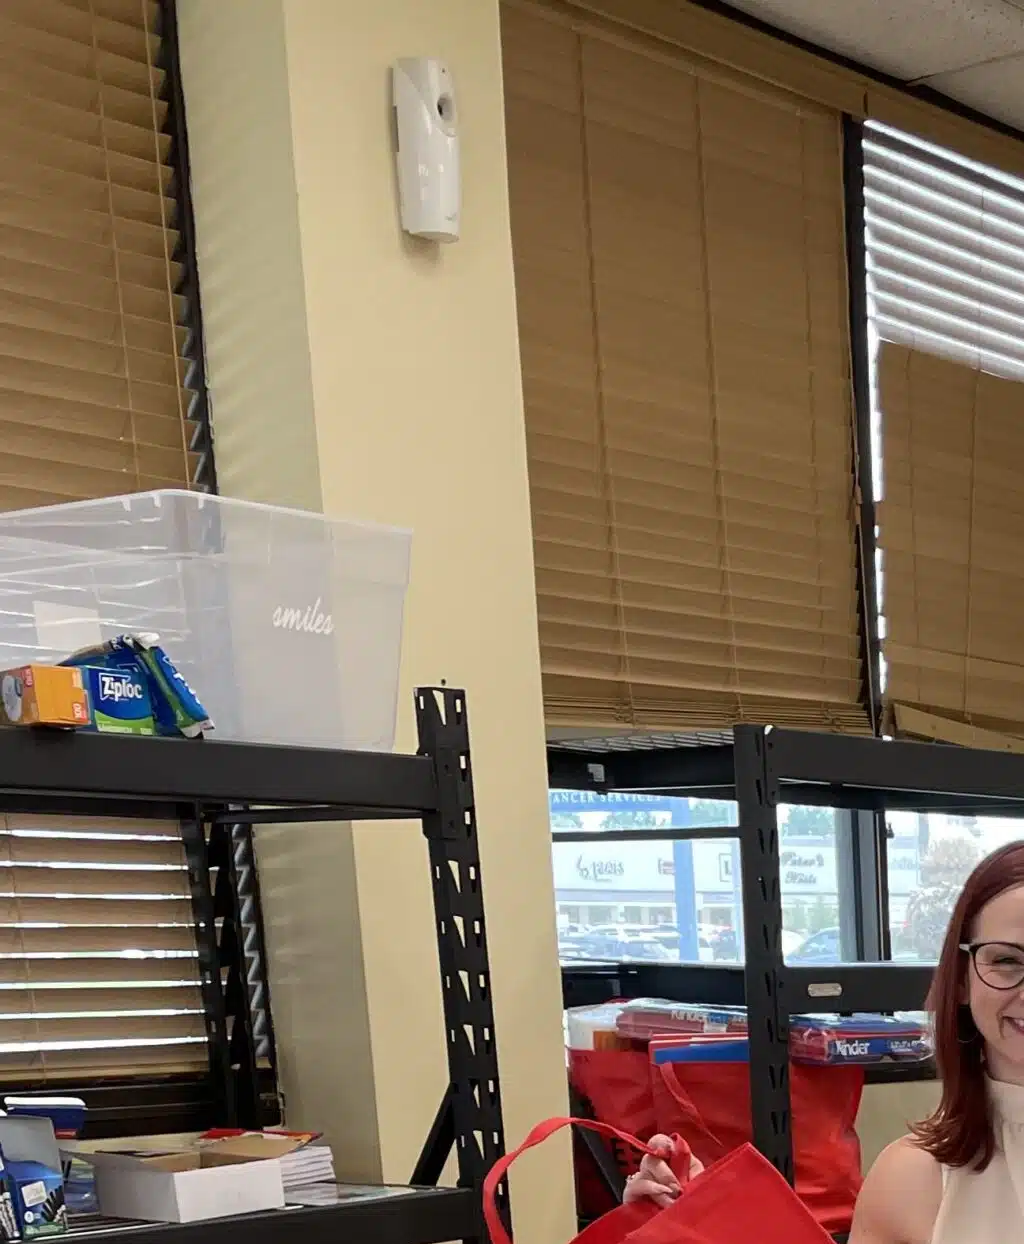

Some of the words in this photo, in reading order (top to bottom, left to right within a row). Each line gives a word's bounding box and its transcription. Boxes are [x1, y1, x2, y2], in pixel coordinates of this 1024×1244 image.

[272, 596, 335, 635] smiles
[101, 676, 143, 701] Ziploc
[835, 1040, 870, 1056] Kinder
